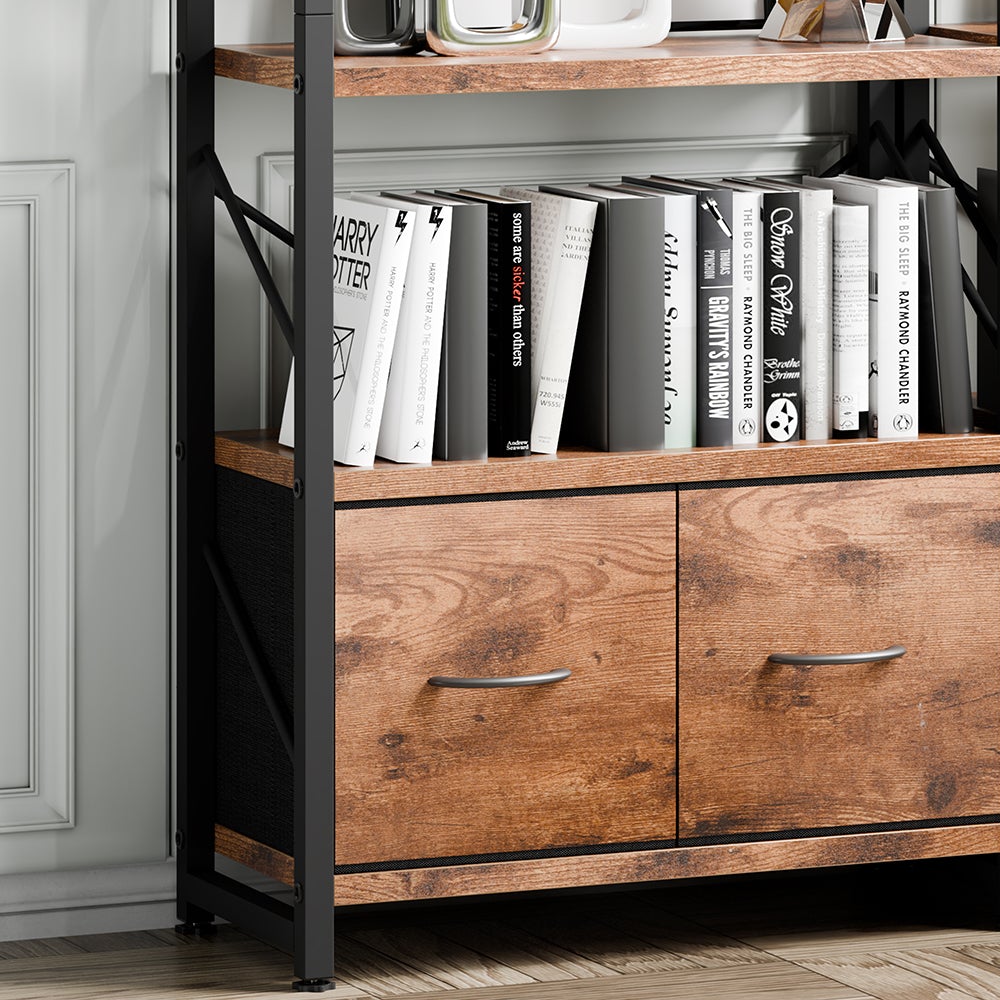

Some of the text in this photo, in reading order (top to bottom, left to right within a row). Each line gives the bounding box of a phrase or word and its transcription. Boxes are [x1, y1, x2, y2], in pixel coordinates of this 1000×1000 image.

[816, 210, 825, 224] An
[562, 242, 573, 250] ND
[815, 225, 825, 288] Architectural
[333, 254, 371, 291] OTTER
[427, 262, 436, 285] HARRY
[703, 250, 716, 280] PYNCHON
[719, 249, 730, 276] THOMAS
[770, 206, 794, 336] Snow White
[389, 266, 397, 289] HARRY
[512, 212, 525, 367] some are sicker than others
[383, 289, 394, 318] POTTER
[425, 286, 435, 314] POTTER
[743, 208, 753, 410] THE BIG SLEEP RAYMOND CHANDLER
[815, 289, 826, 324] History
[898, 202, 910, 405] THE BIG SLEEP RAYMOND CHANDLER
[423, 315, 432, 331] AND
[377, 336, 385, 350] THE
[421, 333, 431, 346] THE
[815, 332, 825, 361] Daniel
[708, 296, 730, 419] GRAVITY'S RAINBOW
[364, 406, 374, 429] STONE
[415, 402, 425, 426] STONE
